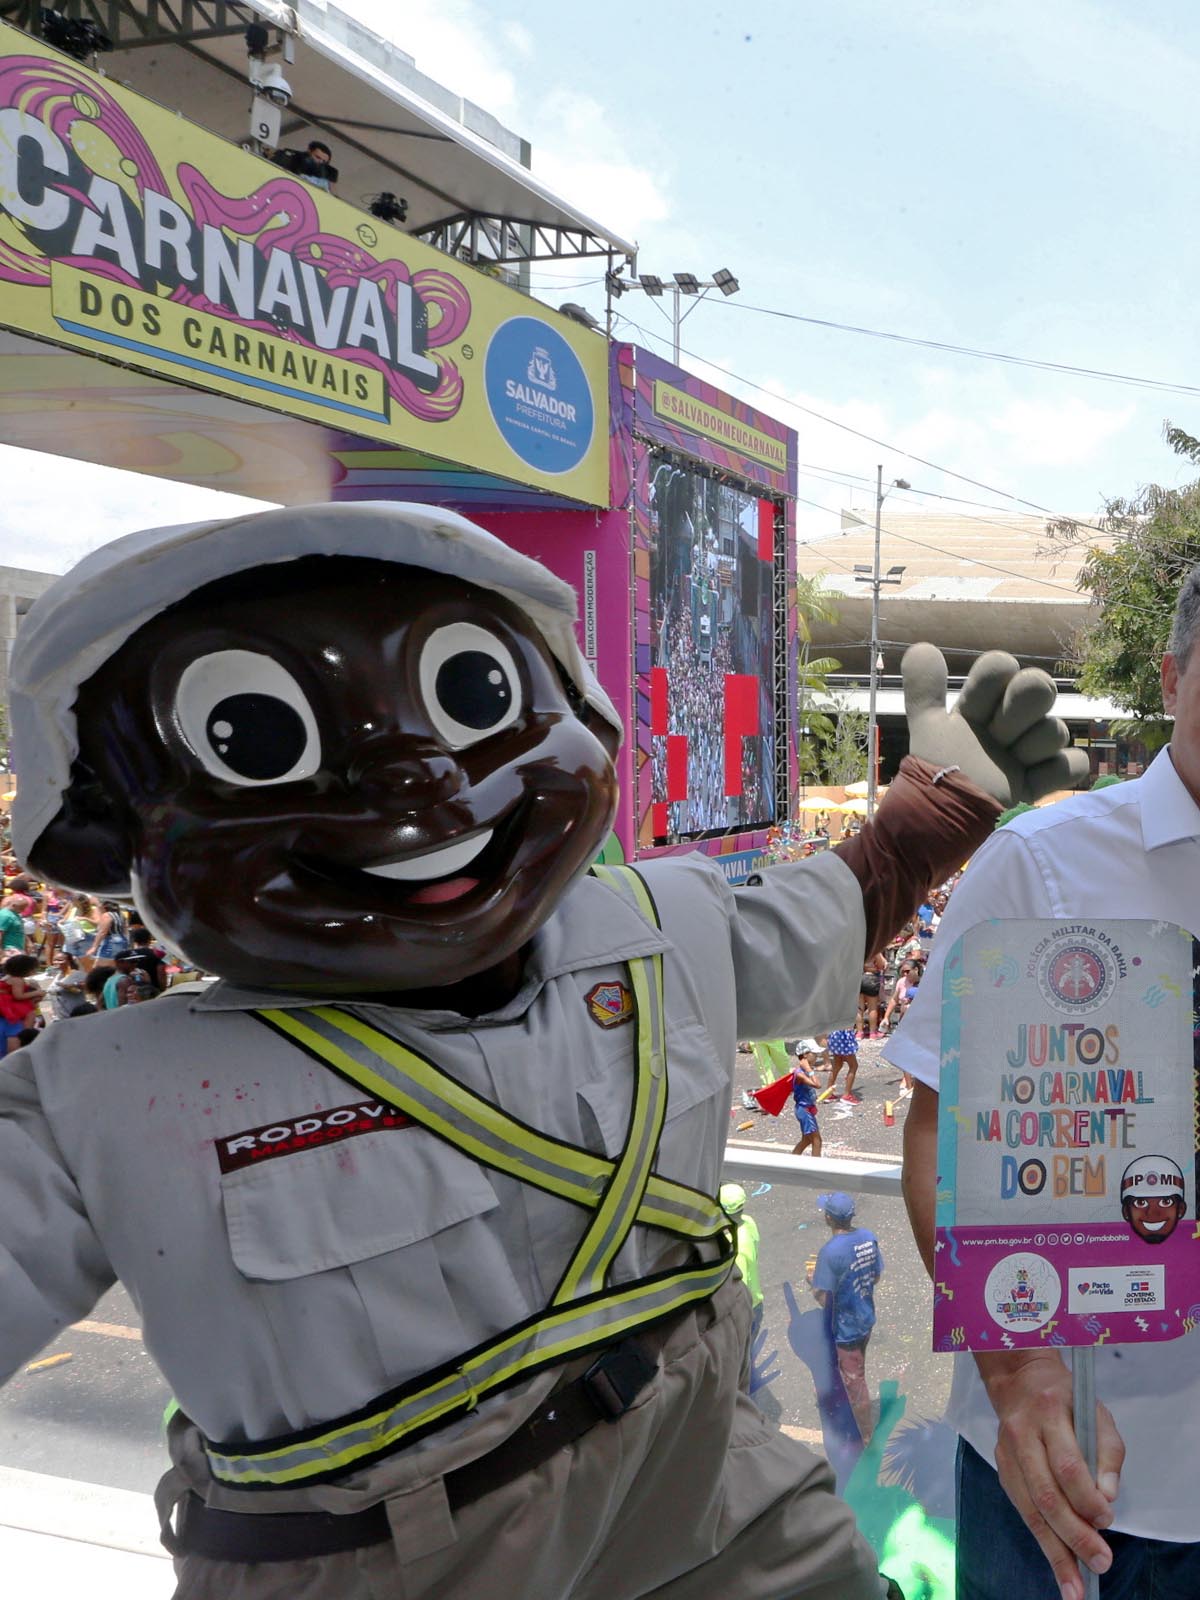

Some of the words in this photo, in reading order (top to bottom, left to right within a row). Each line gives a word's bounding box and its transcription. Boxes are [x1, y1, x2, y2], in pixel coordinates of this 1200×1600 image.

[259, 122, 270, 139] 9
[0, 108, 438, 378] CARNAVAL
[79, 280, 162, 336] DOS
[183, 316, 370, 402] CARNAVAIS
[506, 379, 577, 423] SALVADOR
[516, 403, 568, 430] PREFEITURA
[661, 391, 785, 465] @SALVADORMEUCARNAVAL
[585, 552, 595, 610] MODERAÇÃO
[587, 612, 595, 632] COM
[587, 633, 596, 656] BEBA
[1027, 937, 1051, 978] POLÍCIA
[1051, 925, 1096, 939] MILITAR
[1097, 932, 1112, 946] DA
[1111, 944, 1127, 979] BAHIA
[1006, 1023, 1120, 1068] JUNTOS
[1002, 1074, 1035, 1105] NO
[1039, 1069, 1155, 1106] CARNAVAL
[226, 1104, 396, 1155] RODOV
[977, 1110, 1001, 1142] NA
[1006, 1108, 1136, 1148] CORRENTE
[1001, 1154, 1047, 1199] DO
[1053, 1154, 1106, 1197] BEM
[962, 1237, 1032, 1247] www.pm.ba.gov.br
